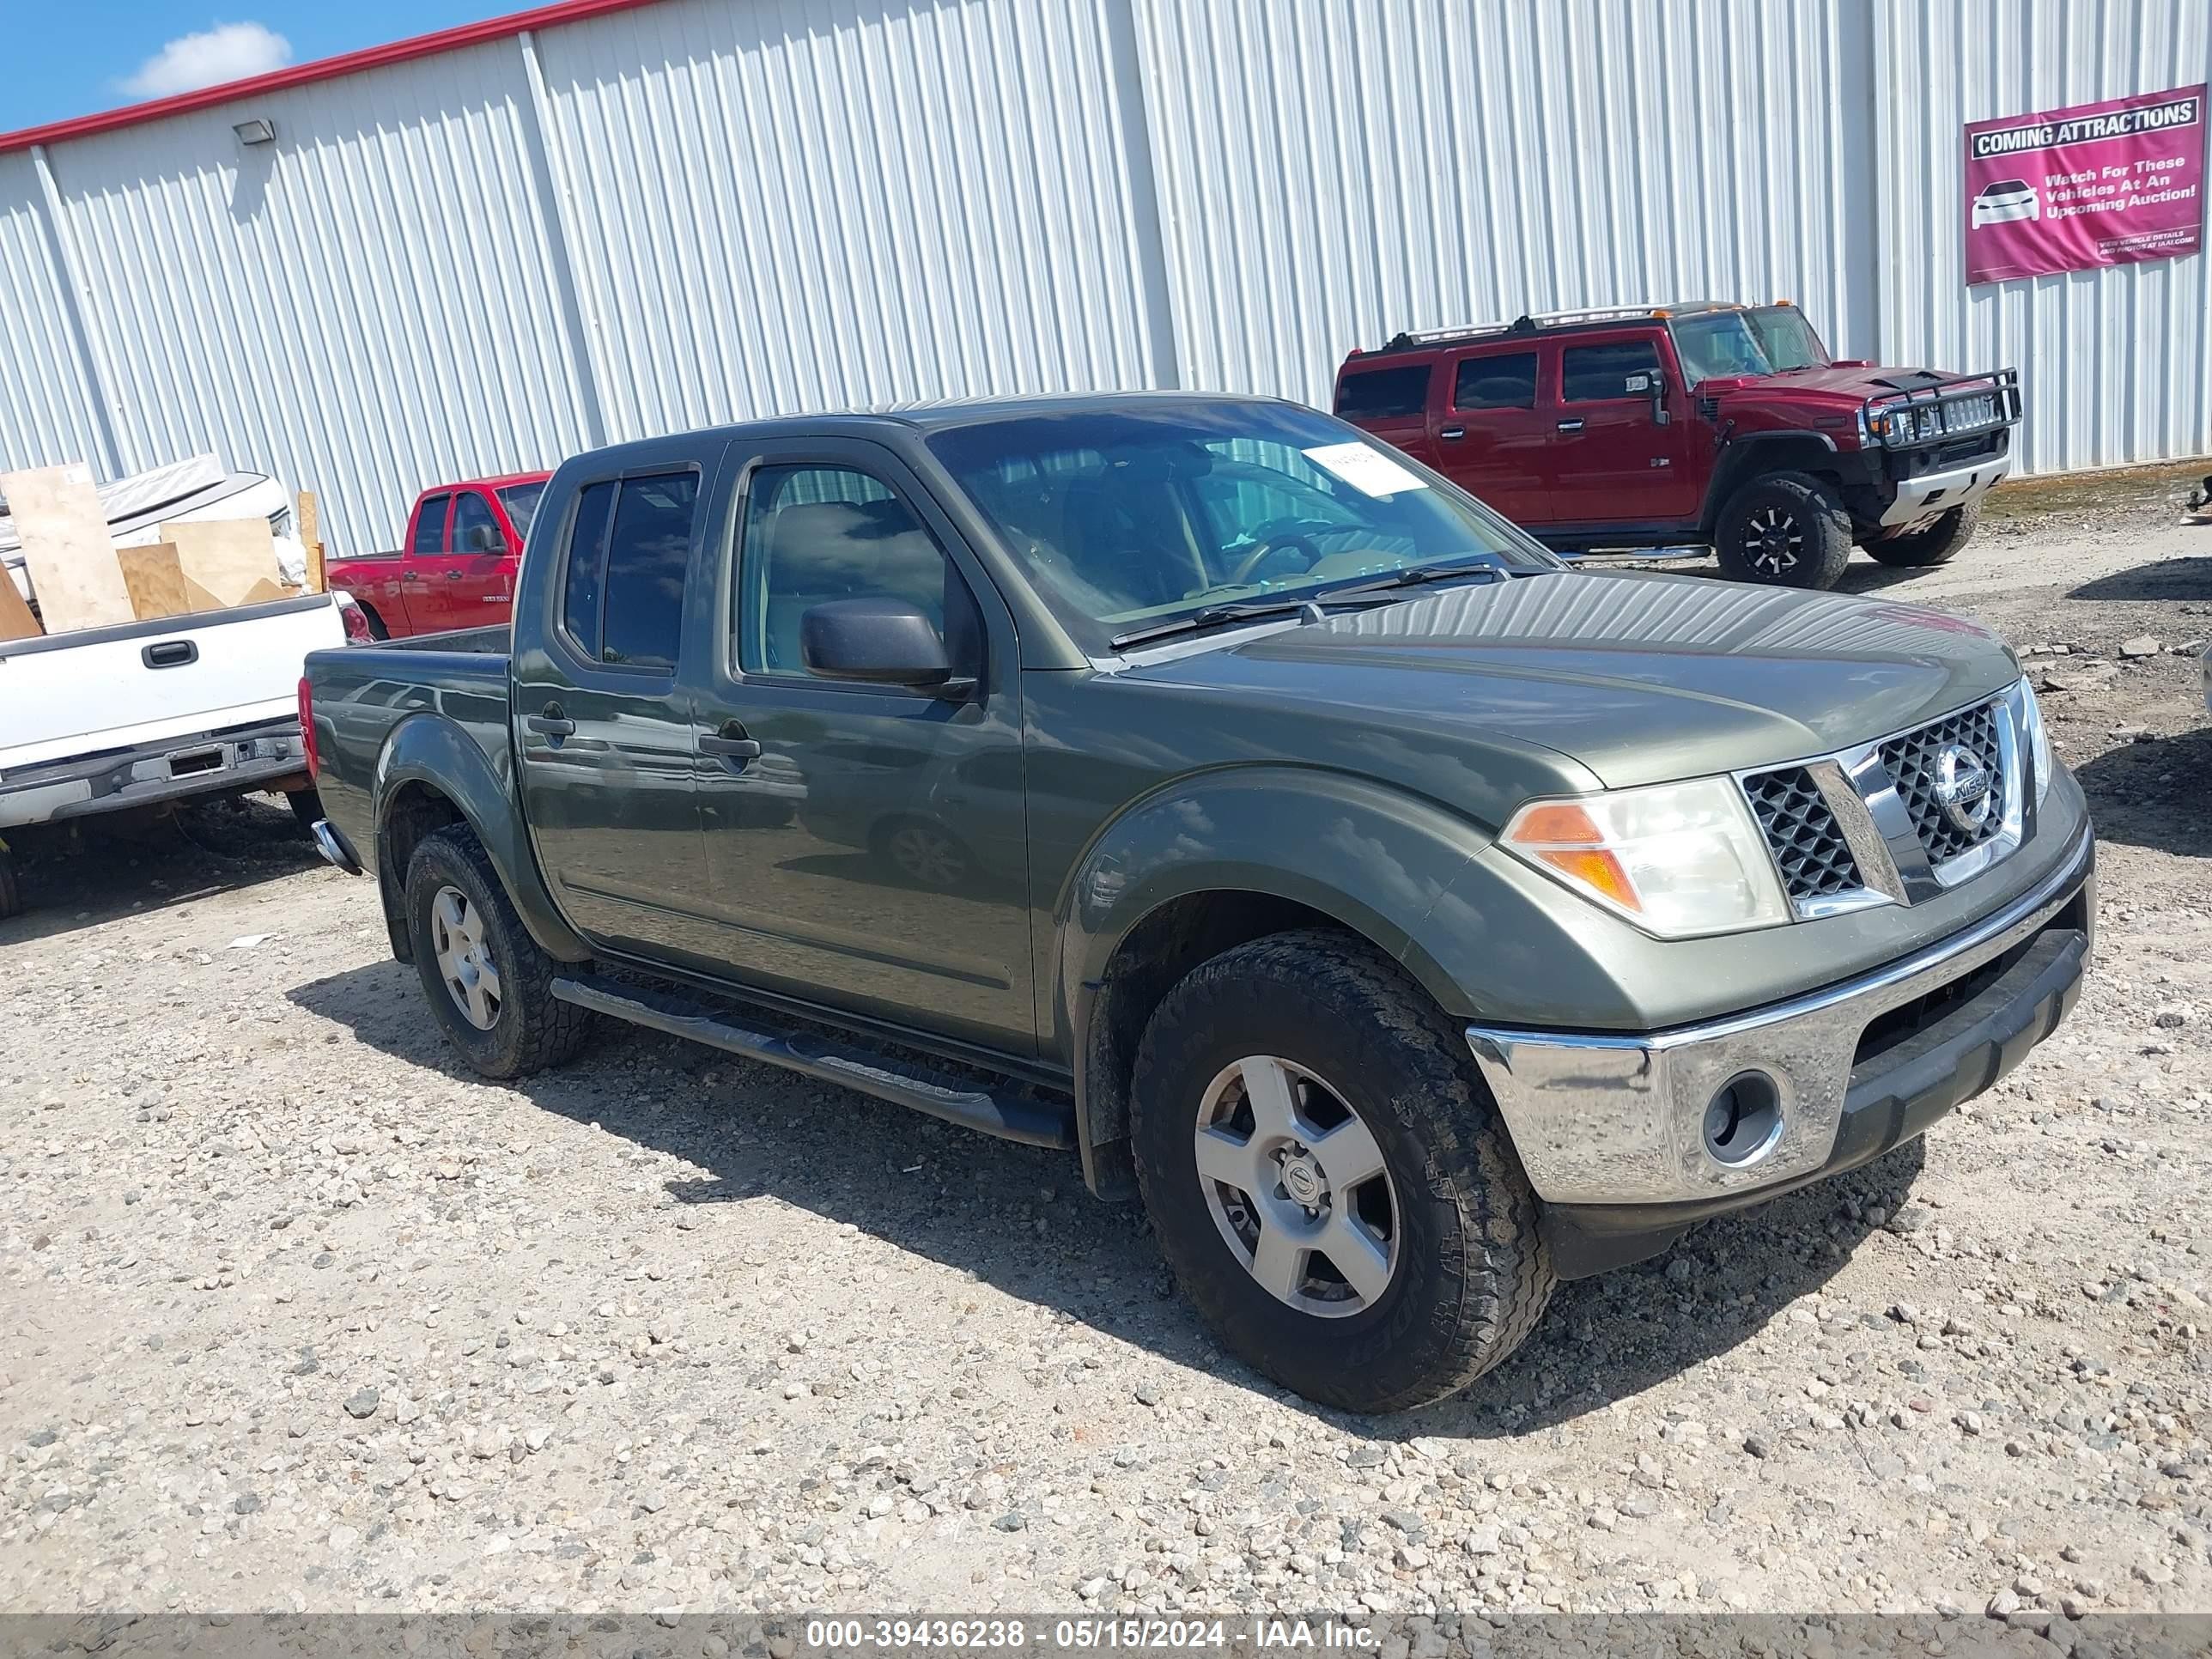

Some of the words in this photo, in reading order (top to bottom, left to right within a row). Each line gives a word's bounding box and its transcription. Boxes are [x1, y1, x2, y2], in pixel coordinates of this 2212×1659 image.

[1978, 126, 2053, 155] COMING
[2057, 102, 2192, 143] ATTRACTIONS
[2045, 169, 2096, 187] Watch
[2102, 166, 2130, 179] For
[2134, 156, 2185, 173] These
[2045, 184, 2116, 203] Vehicles
[2119, 179, 2141, 192] At
[2146, 175, 2170, 188] An
[2046, 198, 2125, 220] Upcoming
[2127, 185, 2197, 207] Auction!
[2119, 237, 2152, 246] VEHICLE
[2153, 230, 2185, 240] DETAILS
